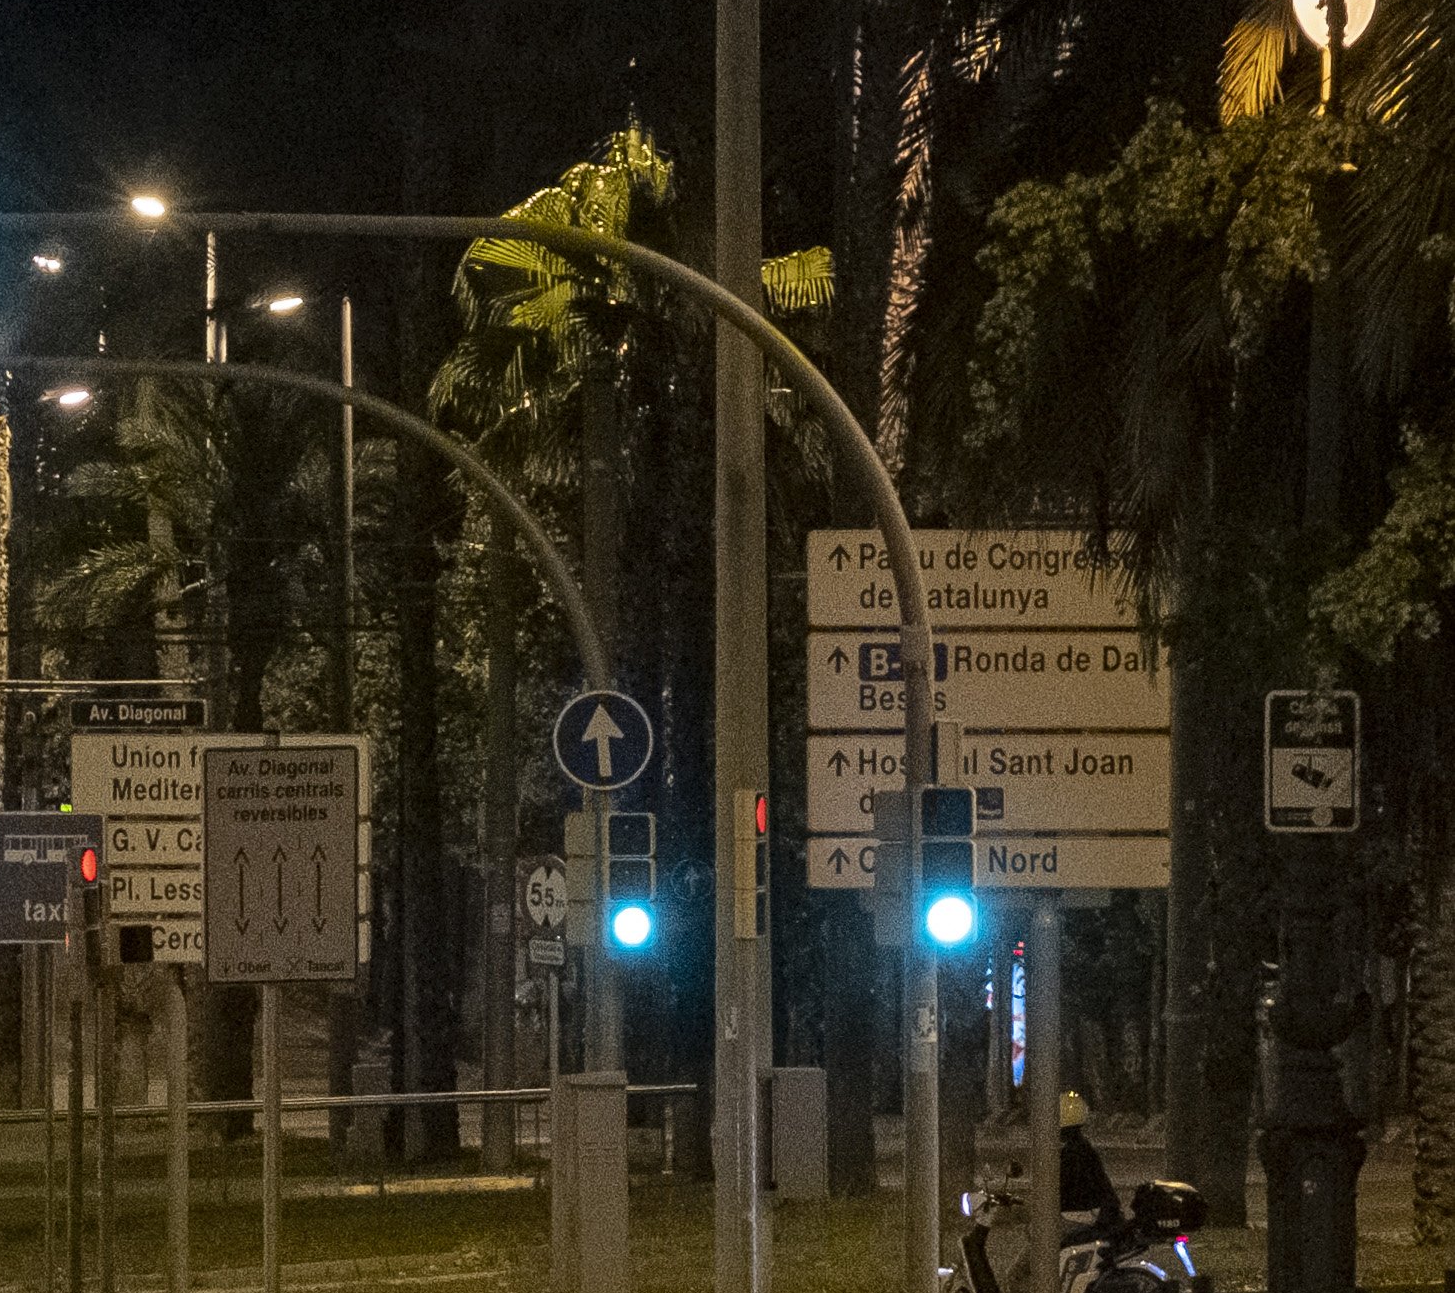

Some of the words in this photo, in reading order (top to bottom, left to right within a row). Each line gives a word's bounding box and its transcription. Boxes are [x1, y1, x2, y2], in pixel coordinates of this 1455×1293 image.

[858, 543, 935, 570] Pau
[945, 543, 978, 570] de
[859, 582, 893, 609] de
[927, 582, 1050, 614] atalunya
[954, 645, 1045, 672] Ronda
[1056, 645, 1089, 672] de
[859, 684, 947, 711] Bess
[89, 704, 114, 720] Av.
[118, 704, 187, 723] Diagonal
[111, 745, 181, 768] Union
[989, 747, 1053, 776] Sant
[1064, 748, 1134, 776] Joan
[227, 760, 252, 776] Av.
[258, 757, 334, 780] Diagonal
[216, 782, 270, 799] carrils
[274, 781, 344, 799] centrals
[233, 804, 328, 822] reversibles
[112, 828, 136, 851] G.
[145, 828, 168, 851] V.
[988, 845, 1058, 874] Nord
[112, 877, 140, 900] Pl.
[23, 898, 68, 922] taxi
